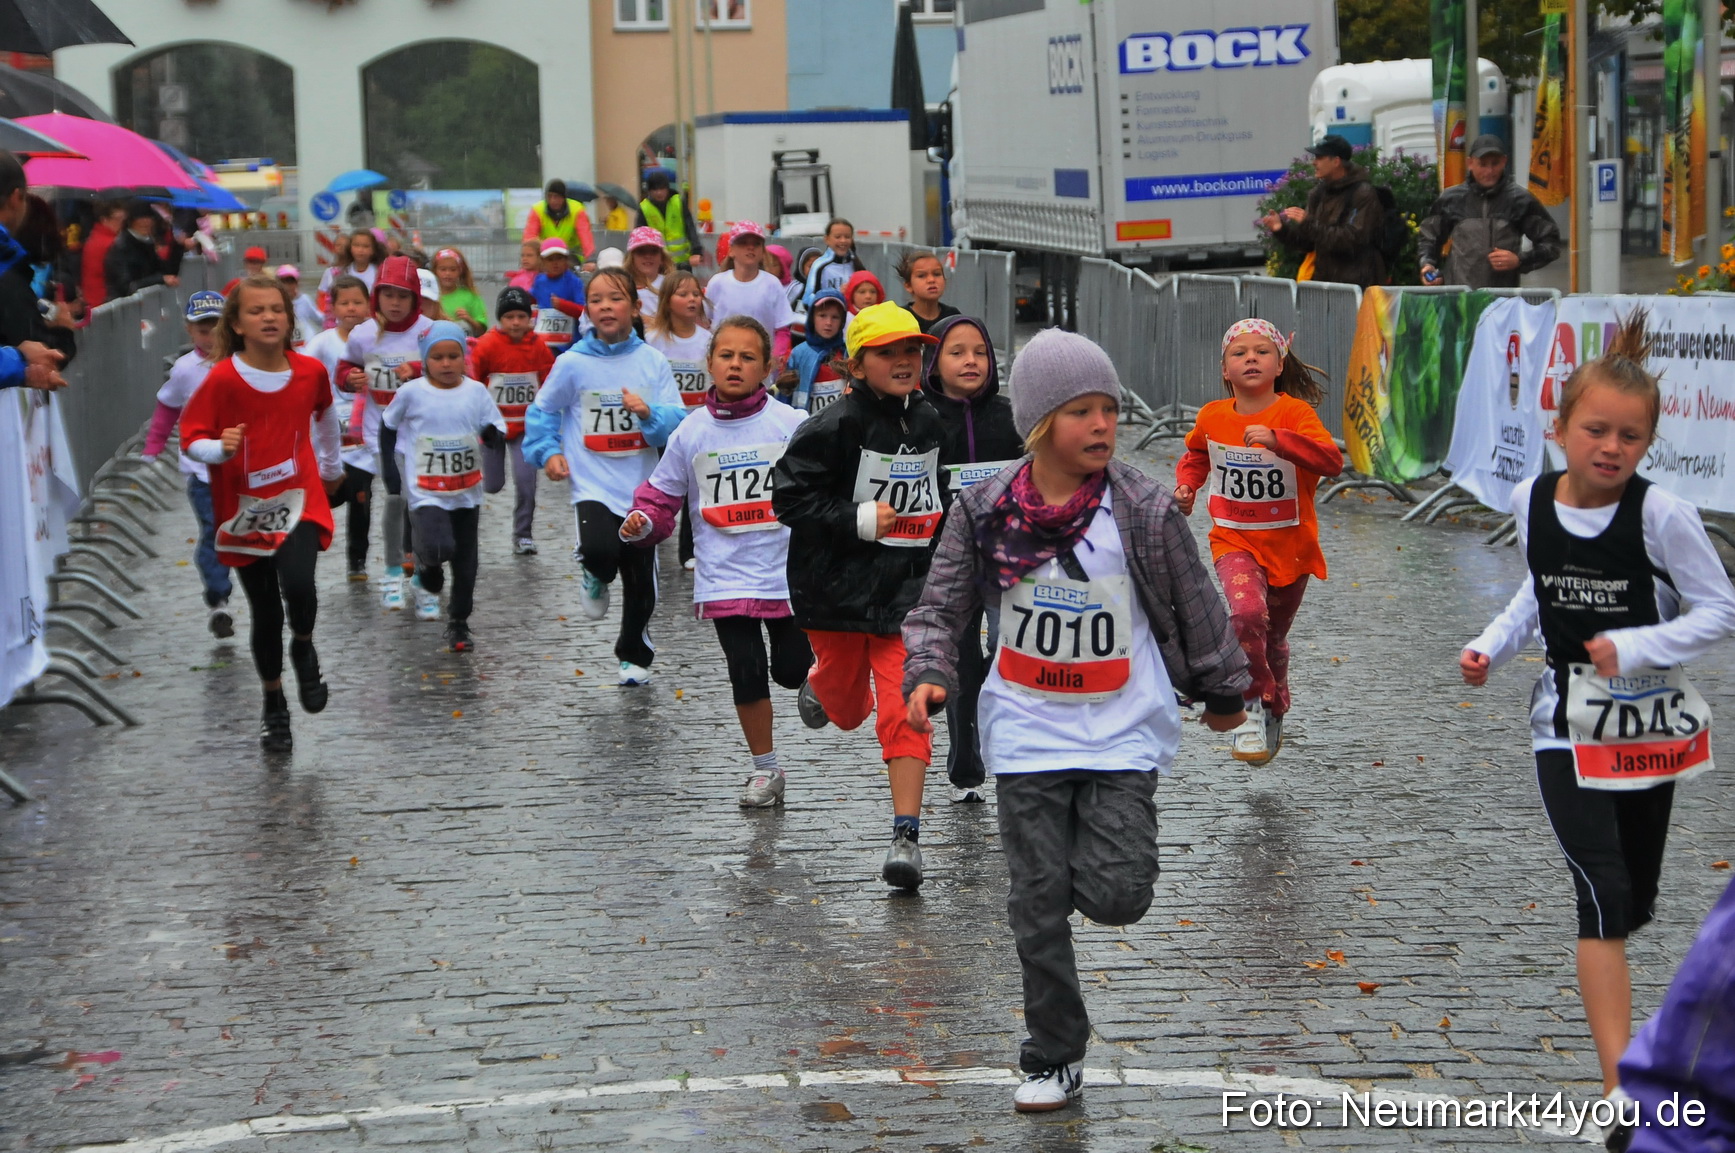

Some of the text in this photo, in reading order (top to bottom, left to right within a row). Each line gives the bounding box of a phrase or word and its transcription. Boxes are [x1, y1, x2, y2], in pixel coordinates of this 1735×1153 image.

[1119, 23, 1311, 74] BOCK
[1049, 34, 1084, 94] BOCK
[1135, 89, 1200, 101] Entwicklung
[1135, 105, 1197, 115] Formenbau
[1136, 117, 1229, 130] Kunststofftechnik
[1138, 150, 1179, 161] Logistik
[1151, 176, 1281, 196] www.bockonline.
[1603, 168, 1614, 186] P
[540, 318, 568, 332] 7267
[674, 372, 705, 391] 320
[494, 385, 534, 404] 7066
[1698, 385, 1735, 421] Neum
[590, 407, 633, 433] 713
[423, 449, 474, 474] 7185
[718, 450, 758, 465] BOCK
[1226, 451, 1262, 462] BOCK
[706, 467, 775, 504] 7124
[1216, 464, 1285, 500] 7368
[869, 476, 934, 514] 7023
[727, 508, 764, 523] Laura
[1034, 584, 1089, 605] BOCK
[1558, 588, 1617, 604] LANGE
[1012, 604, 1115, 659] 7010
[1036, 666, 1084, 688] Julia
[1609, 674, 1667, 690] BOCK
[1586, 692, 1700, 741] 7043
